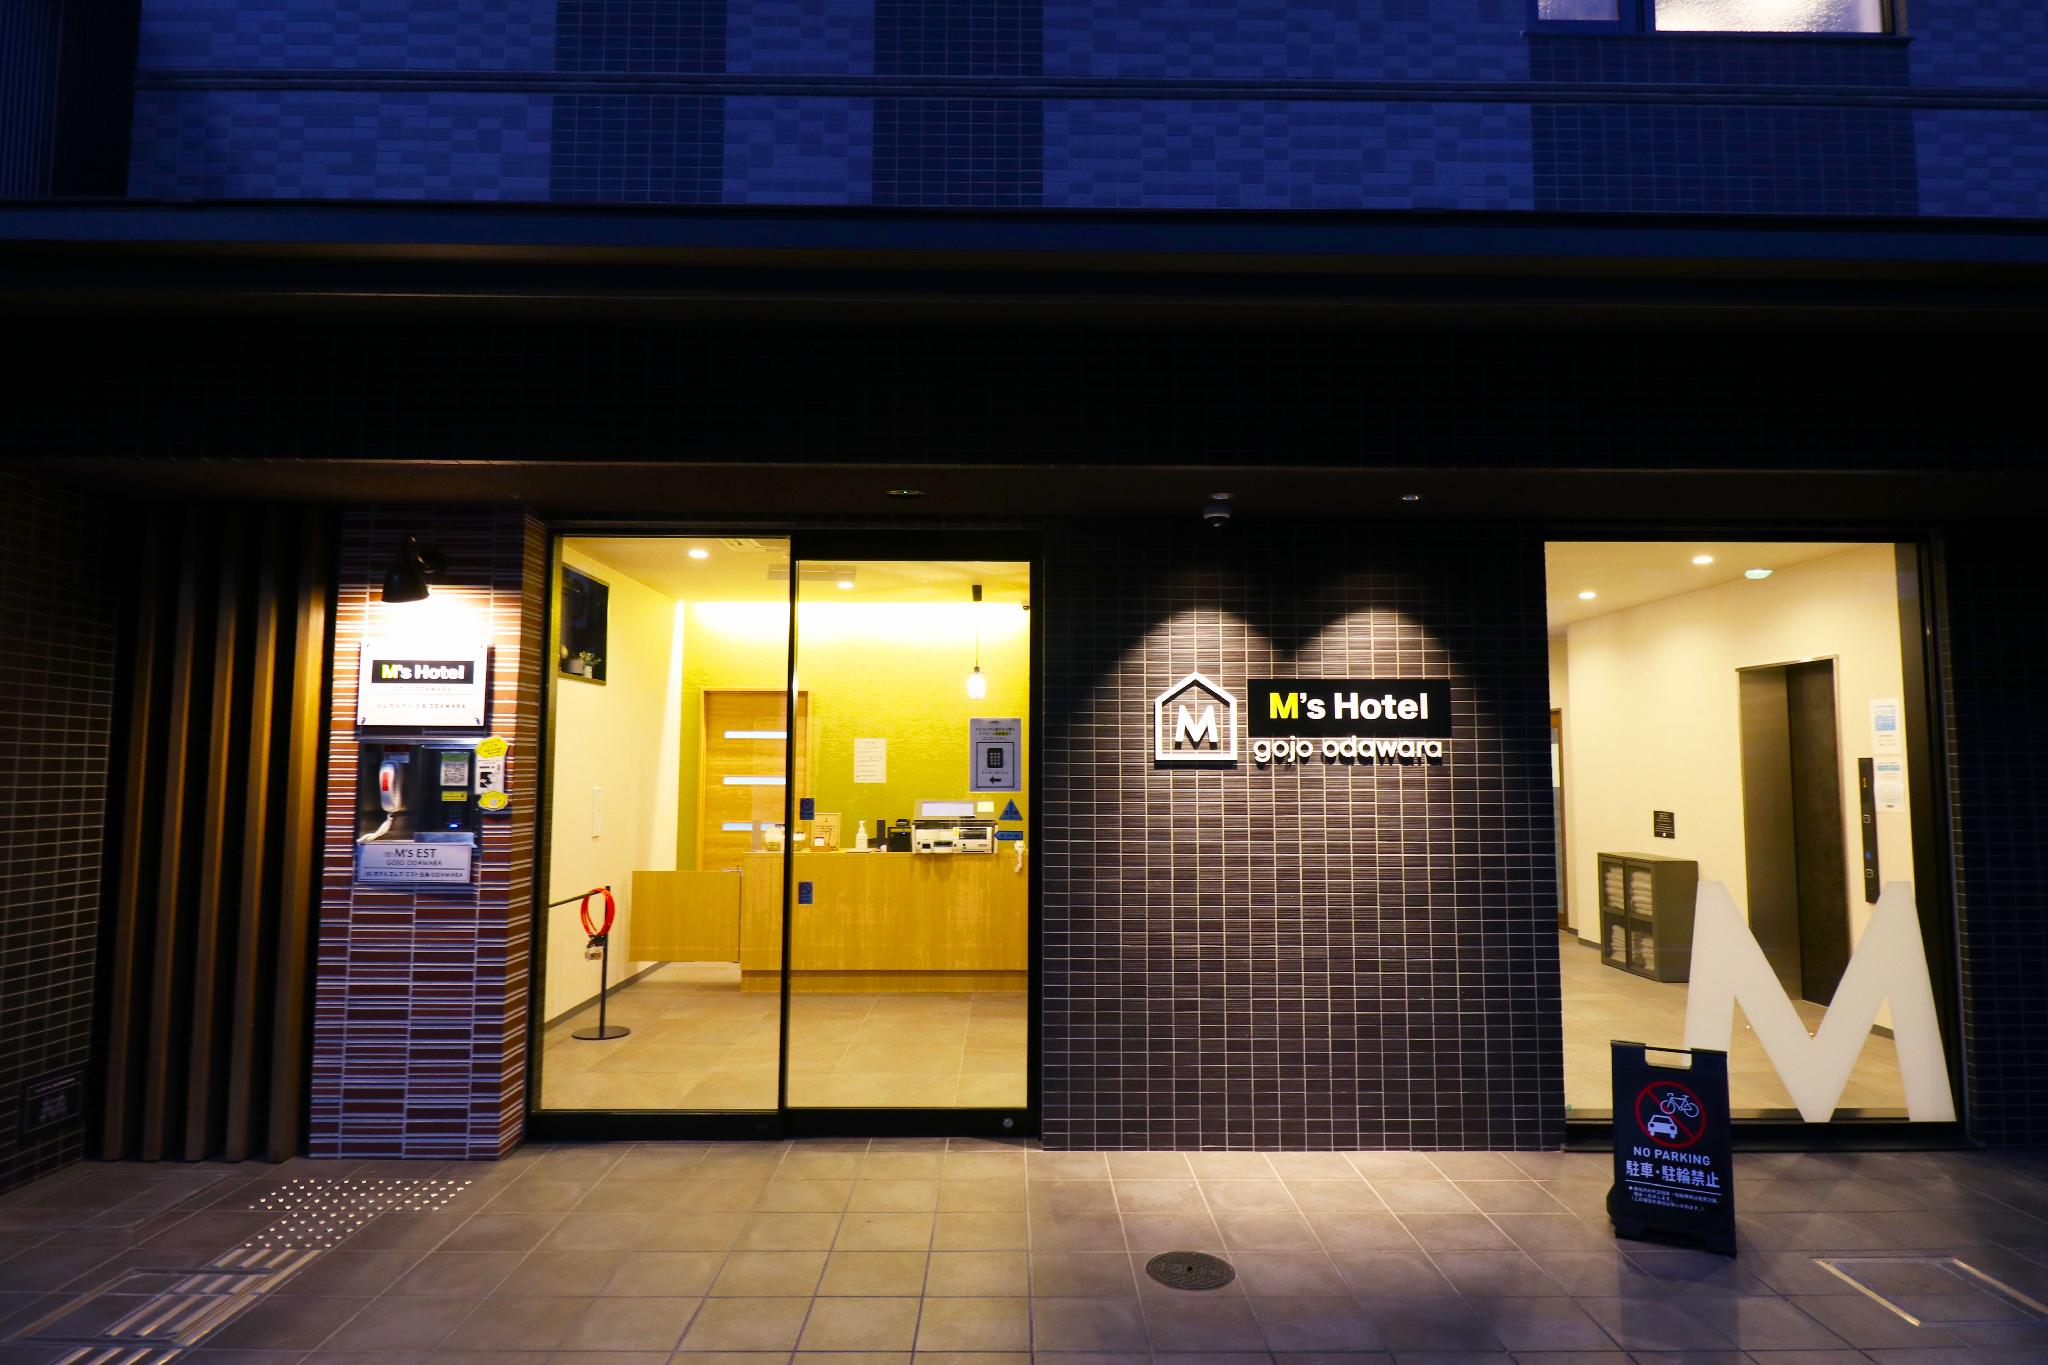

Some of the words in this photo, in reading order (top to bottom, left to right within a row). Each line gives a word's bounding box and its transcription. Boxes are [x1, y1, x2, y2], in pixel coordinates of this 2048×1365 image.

[381, 664, 412, 679] M's
[414, 664, 465, 680] Hotel
[1269, 692, 1326, 720] M's
[1334, 692, 1429, 720] Hotel
[1174, 704, 1219, 743] M
[1253, 735, 1314, 763] gojo
[1322, 735, 1443, 758] odawara
[394, 848, 414, 858] M's
[416, 848, 438, 858] EST
[1683, 881, 1957, 1123] M
[1633, 1146, 1651, 1157] NO
[1654, 1149, 1711, 1166] PARKING
[1625, 1160, 1720, 1188] 駐車・駐輪禁止
